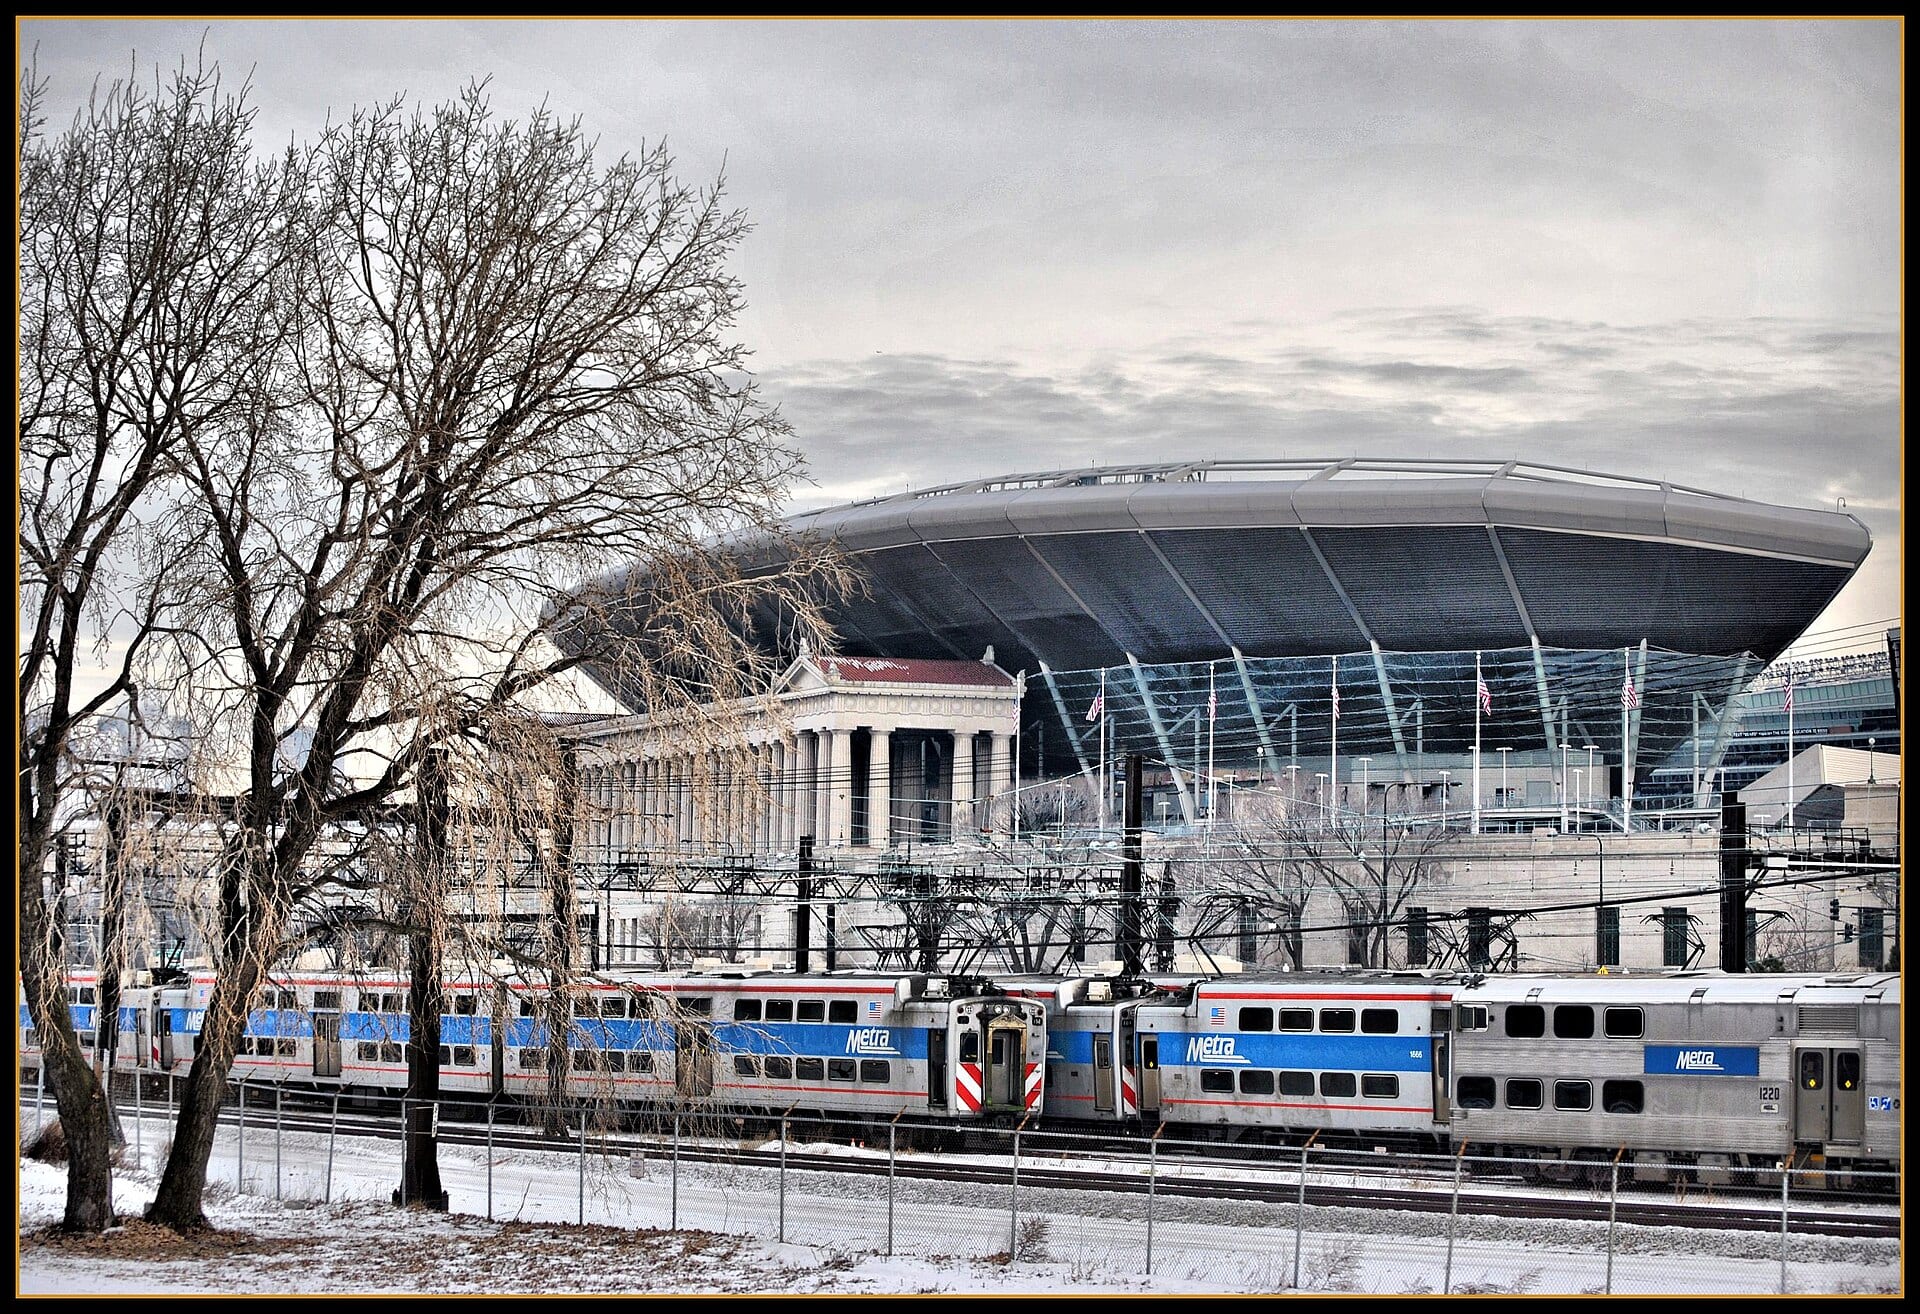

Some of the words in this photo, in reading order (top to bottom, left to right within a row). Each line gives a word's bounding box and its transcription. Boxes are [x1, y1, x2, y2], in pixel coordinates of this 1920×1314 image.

[846, 1026, 900, 1055] Metra
[1186, 1034, 1251, 1064] Metra
[1676, 1050, 1724, 1070] Metra
[1759, 1087, 1780, 1100] 1220
